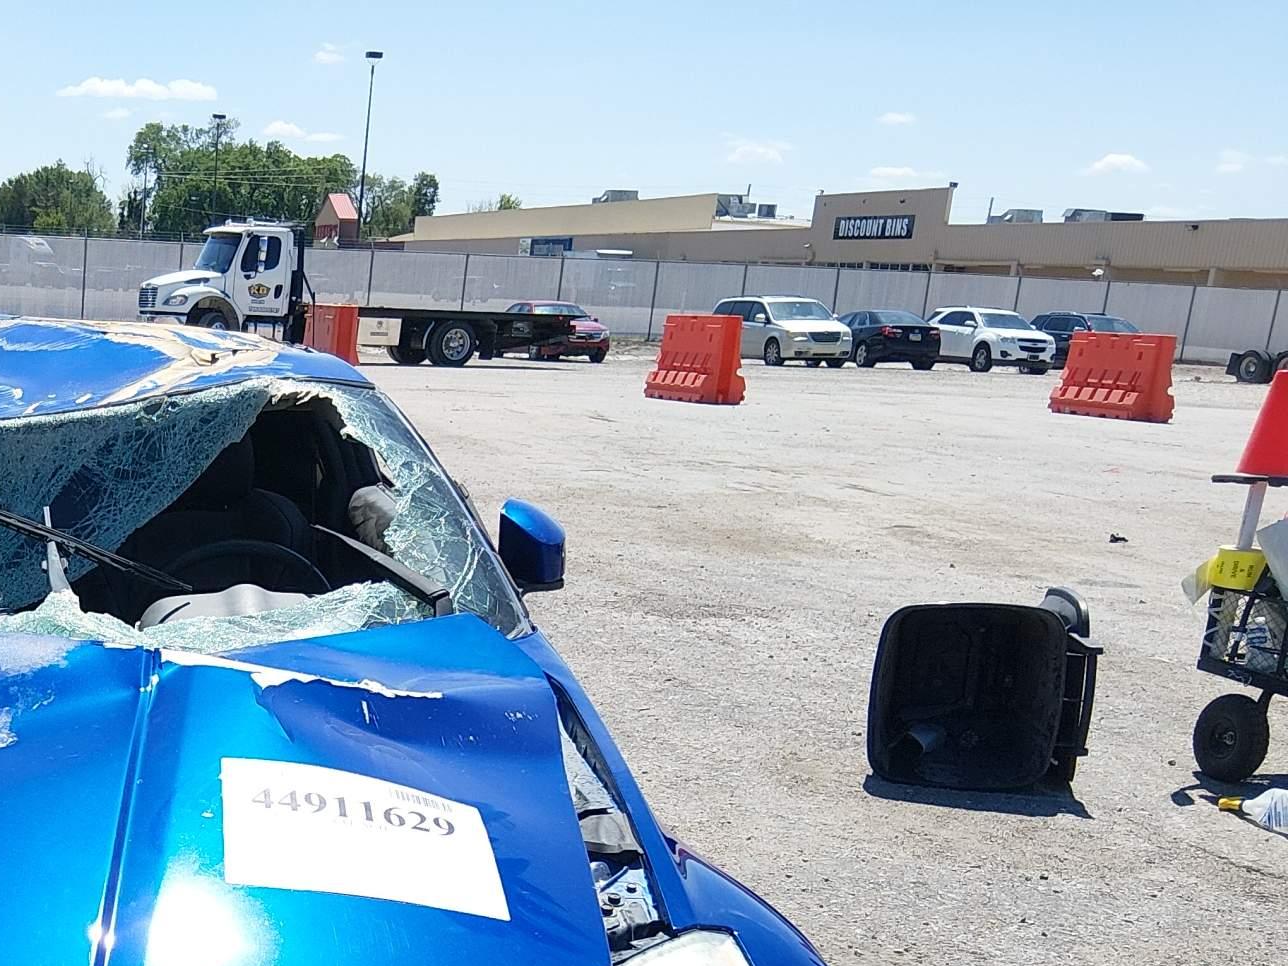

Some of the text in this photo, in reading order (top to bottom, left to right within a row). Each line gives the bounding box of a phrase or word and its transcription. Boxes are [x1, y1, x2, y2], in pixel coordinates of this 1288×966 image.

[838, 218, 909, 237] DISCOUNT BINS
[251, 788, 456, 836] 44911629
